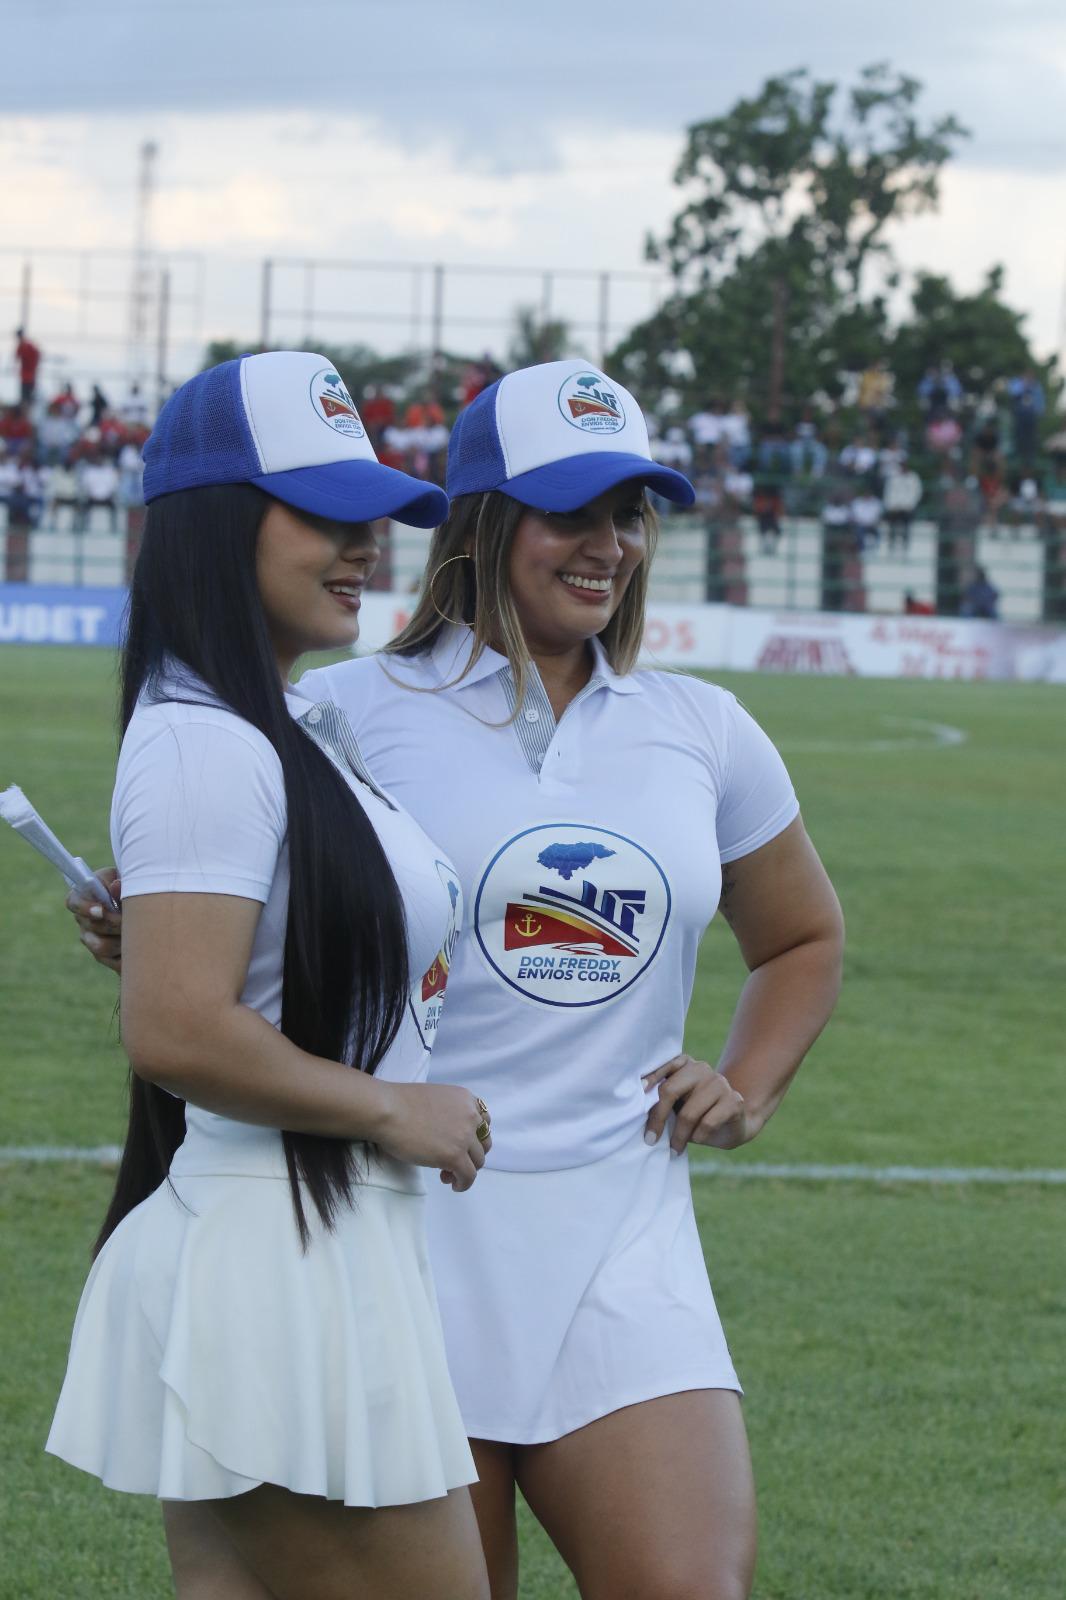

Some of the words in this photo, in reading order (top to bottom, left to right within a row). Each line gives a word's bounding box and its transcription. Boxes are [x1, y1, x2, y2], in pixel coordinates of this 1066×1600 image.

[520, 956, 555, 968] DON
[559, 957, 621, 970] FREDDY
[517, 968, 573, 981] ENVIOS
[577, 970, 621, 982] CORP.
